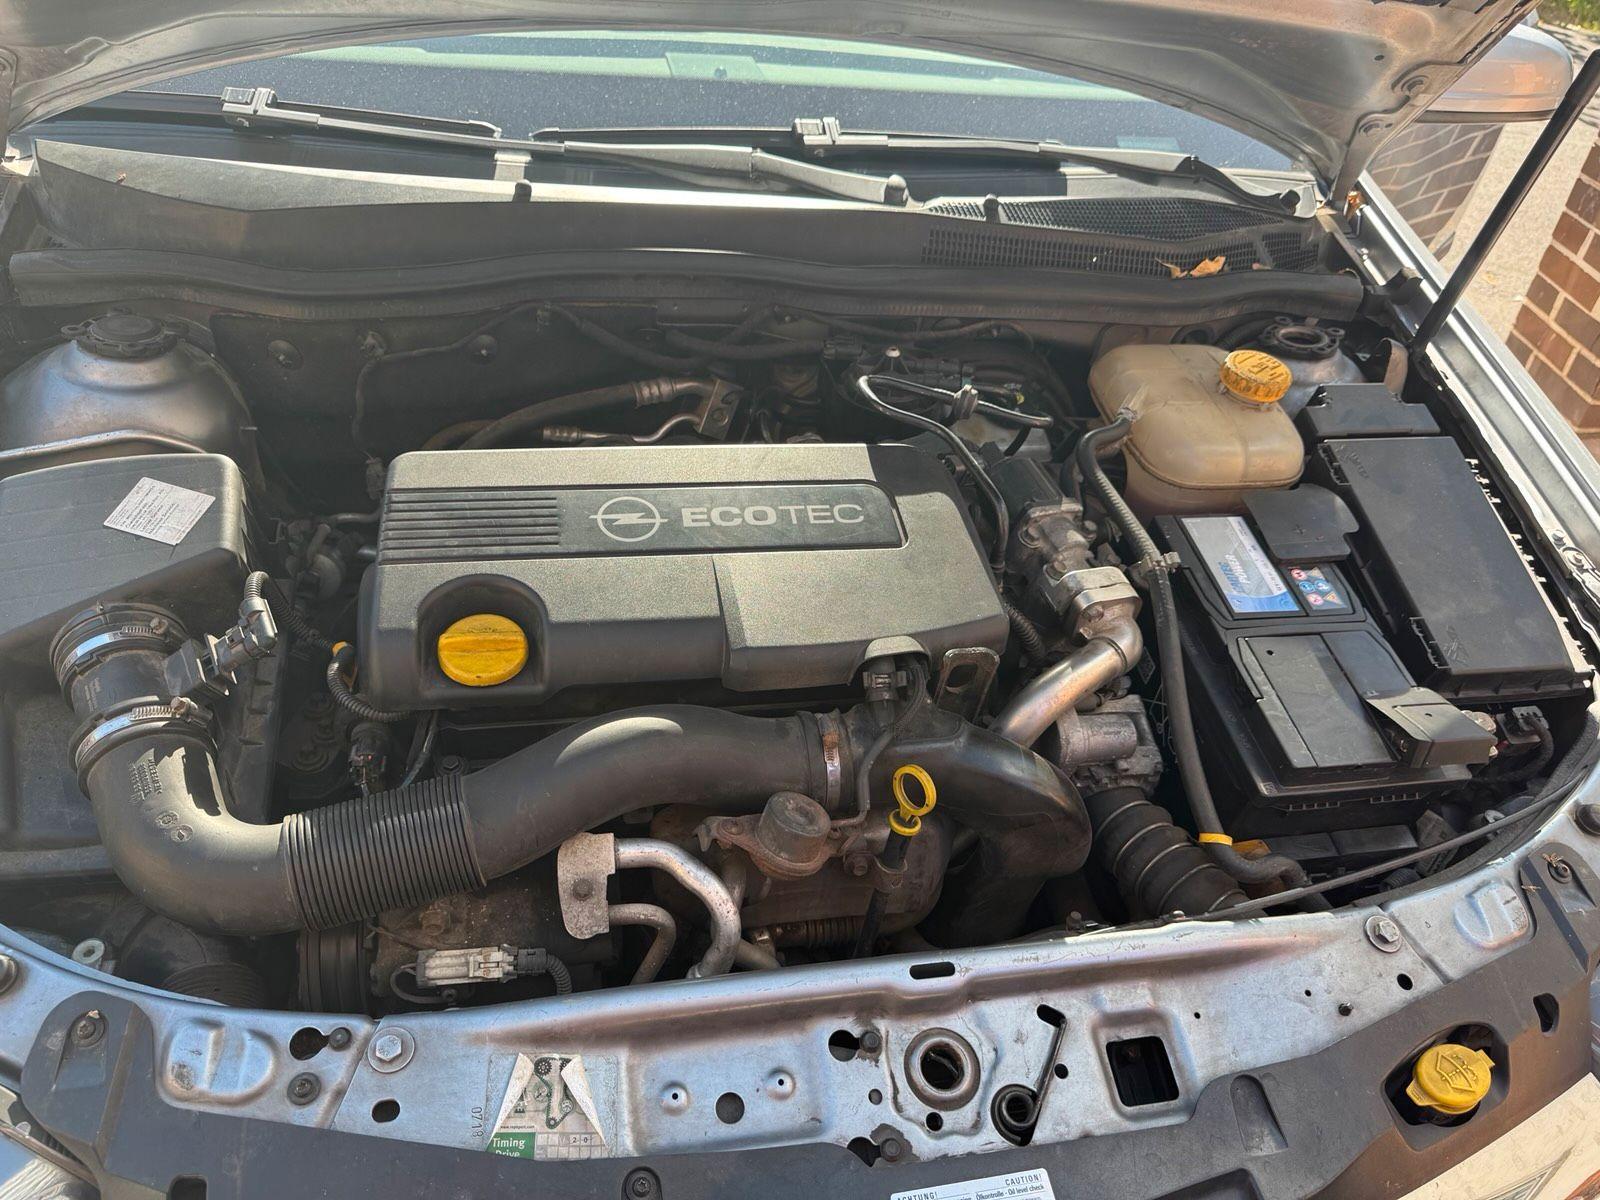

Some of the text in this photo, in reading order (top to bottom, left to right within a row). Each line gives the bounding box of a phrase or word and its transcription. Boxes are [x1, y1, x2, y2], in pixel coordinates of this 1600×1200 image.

[681, 504, 865, 527] ECOTEC
[1224, 553, 1251, 584] POWER
[471, 1106, 484, 1138] 0718
[493, 1137, 525, 1149] Timing
[1005, 1174, 1042, 1186] CAUTION!
[1016, 1186, 1029, 1194] level
[1029, 1184, 1045, 1192] check
